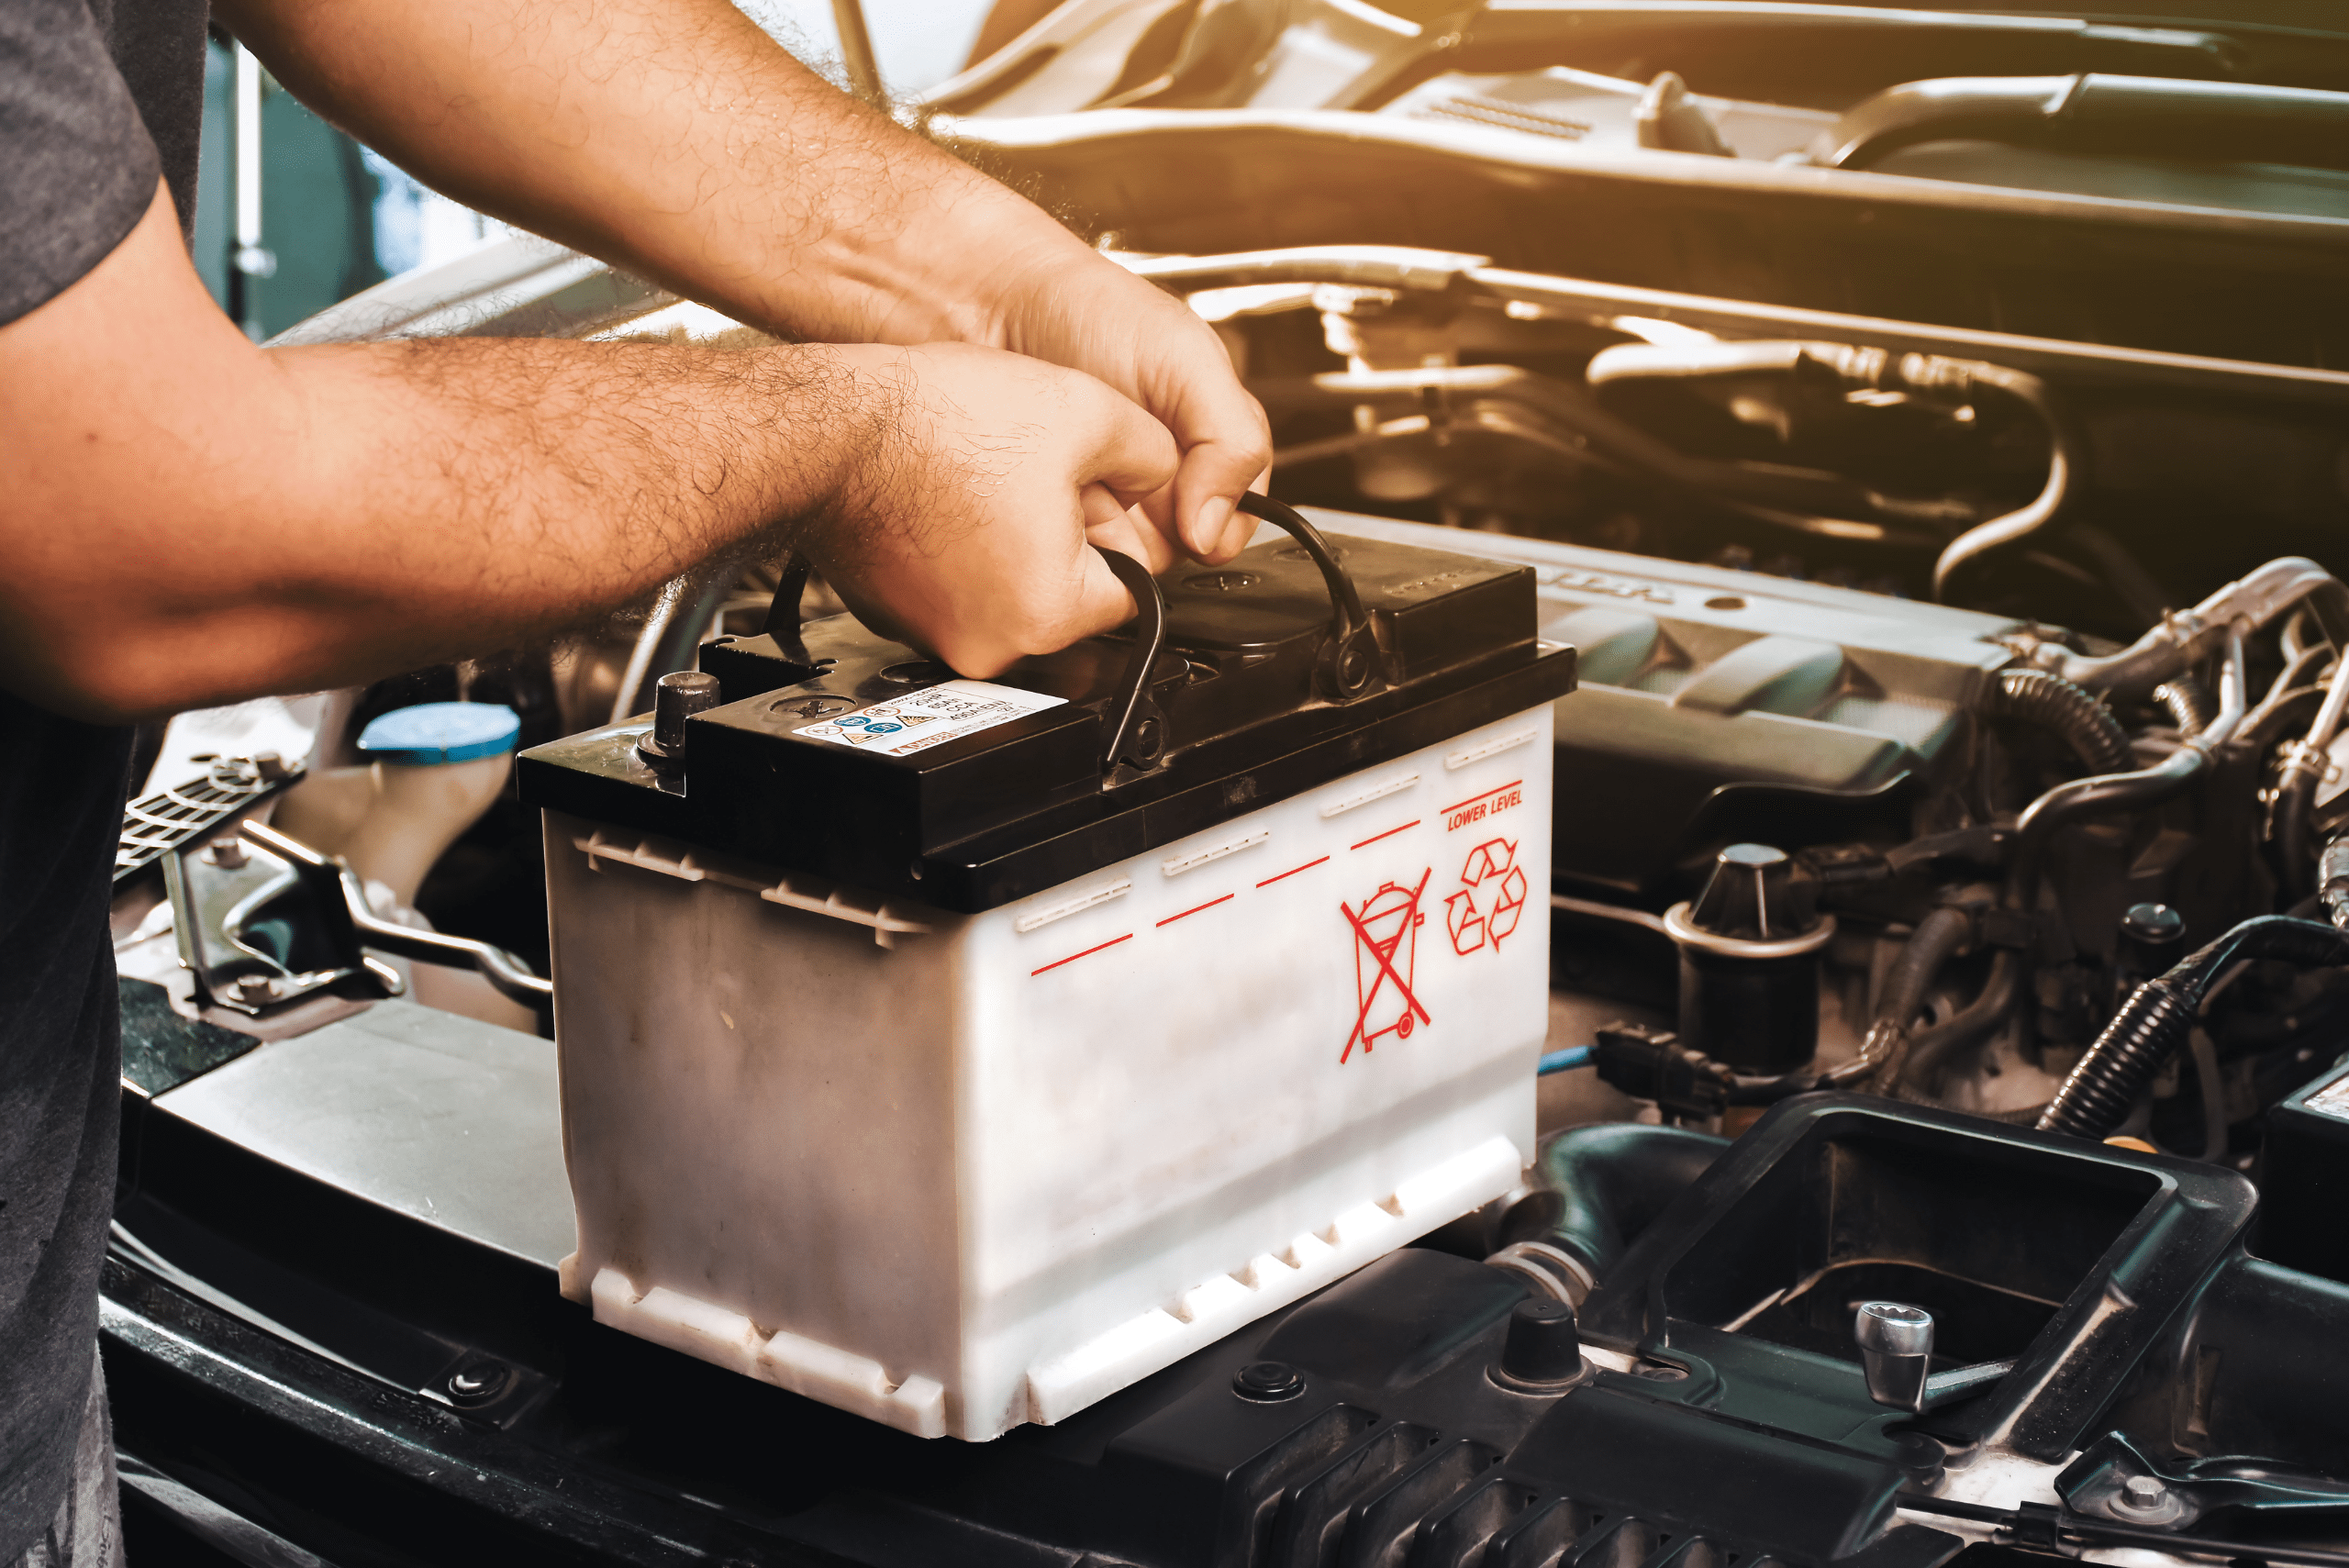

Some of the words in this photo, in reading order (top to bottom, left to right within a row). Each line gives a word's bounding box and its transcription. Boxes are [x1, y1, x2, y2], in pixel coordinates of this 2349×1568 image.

[946, 701, 978, 712] CCA
[909, 732, 956, 749] DANGER
[1448, 804, 1487, 832] LOWER
[1491, 790, 1522, 815] LEVEL
